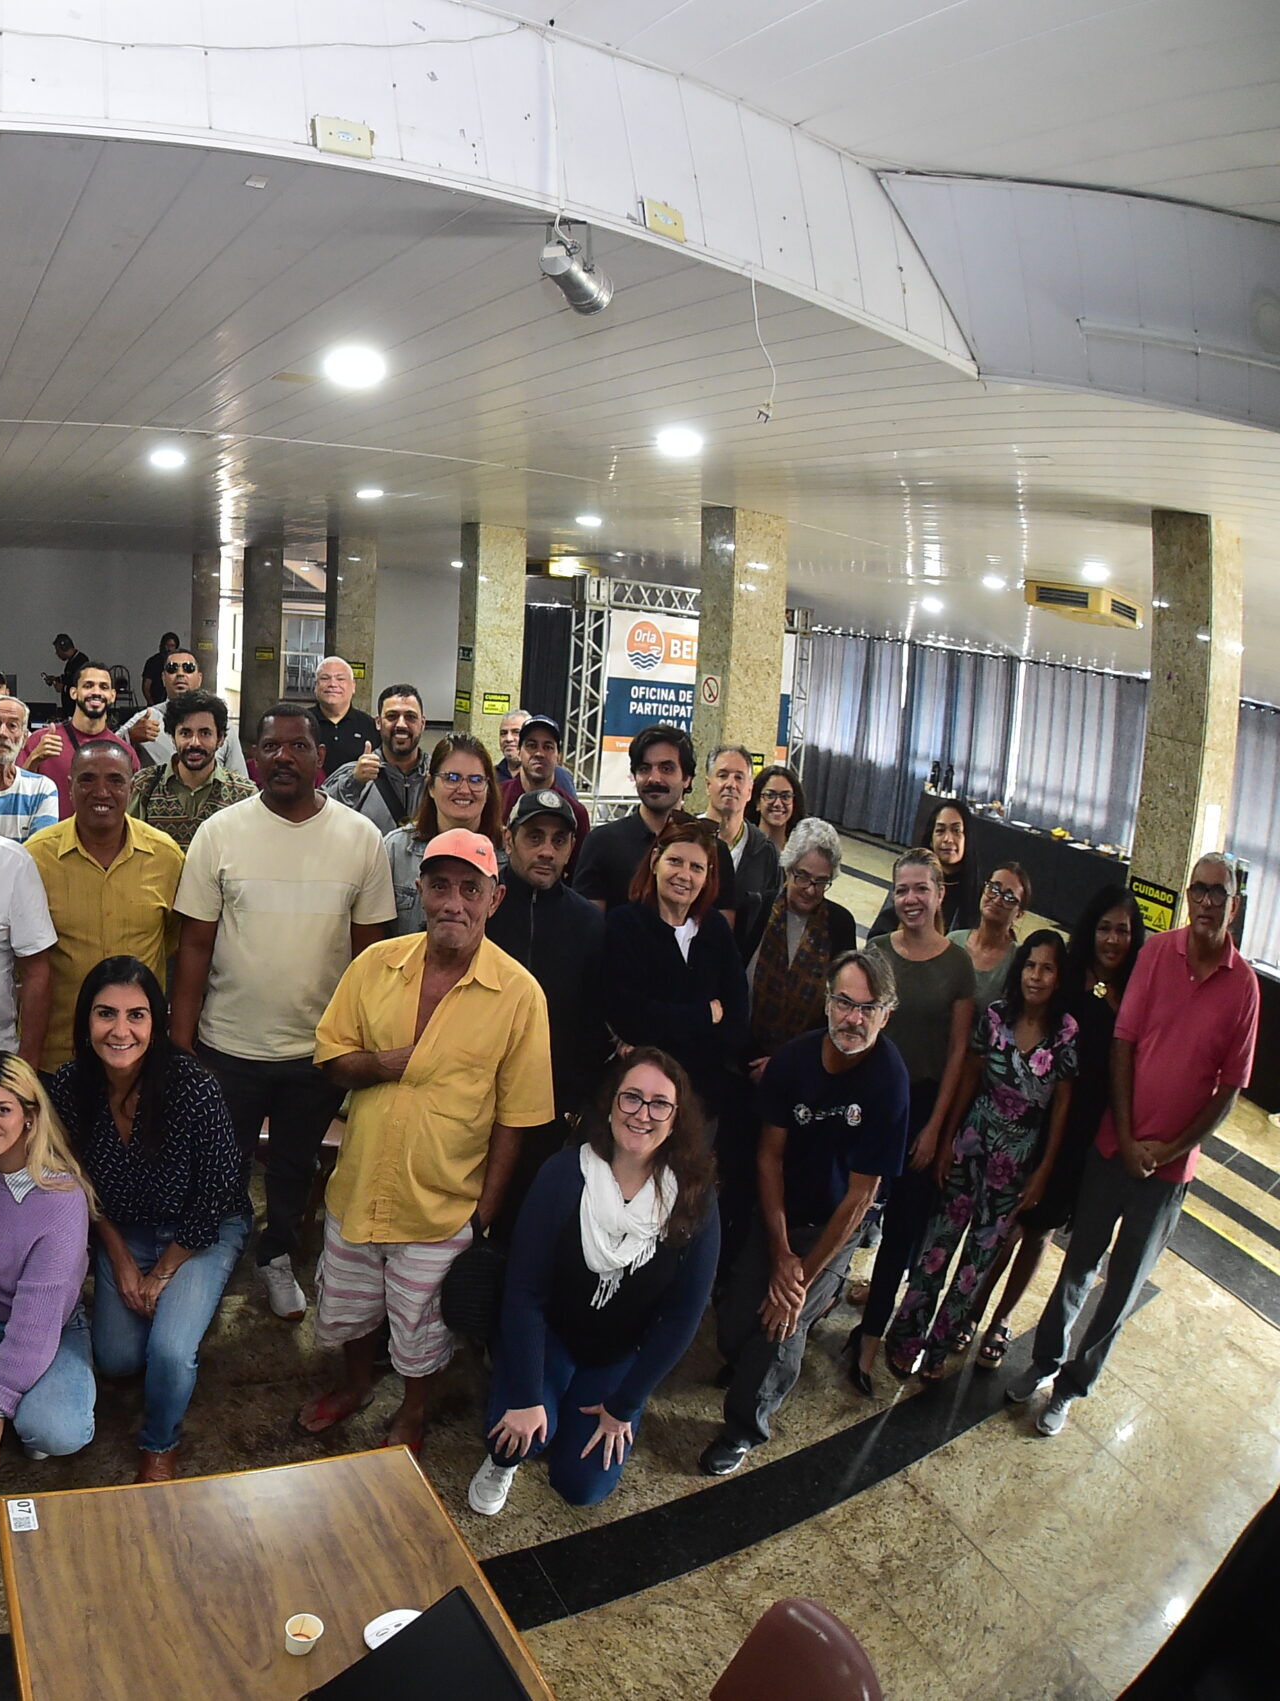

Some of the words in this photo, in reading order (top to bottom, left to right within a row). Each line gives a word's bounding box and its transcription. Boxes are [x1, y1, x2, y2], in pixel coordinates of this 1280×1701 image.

[634, 629, 657, 643] Orla
[631, 686, 676, 701] OFICINA
[679, 690, 693, 703] DE
[629, 702, 693, 718] PARTICIPAT
[1132, 881, 1174, 904] CUIDADO
[17, 1501, 32, 1514] 07
